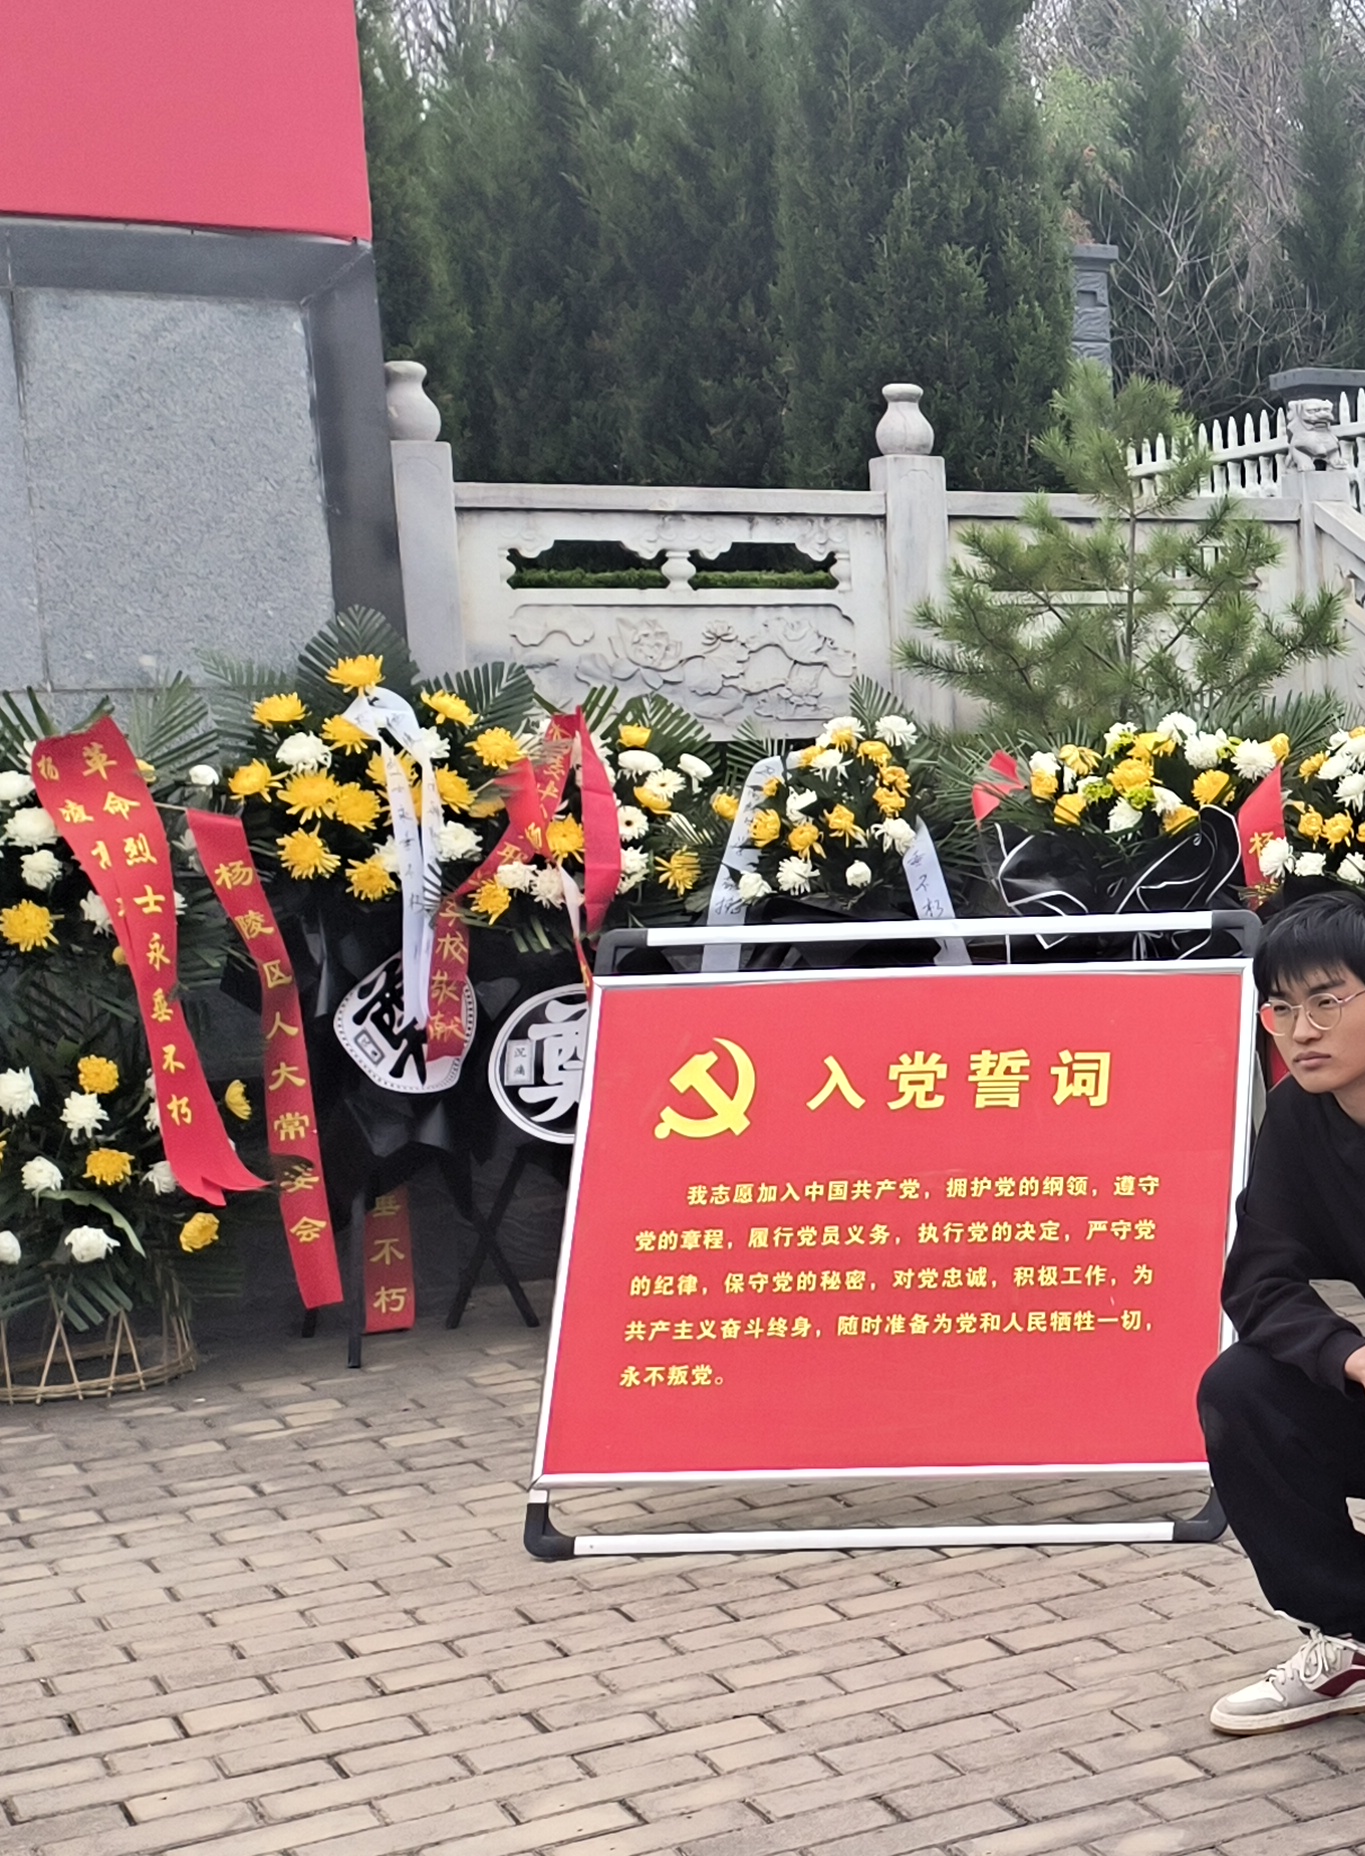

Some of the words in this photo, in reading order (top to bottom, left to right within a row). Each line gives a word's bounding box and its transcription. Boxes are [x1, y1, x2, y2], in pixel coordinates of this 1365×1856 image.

[82, 741, 193, 1127] 革命烈士永垂不朽
[214, 860, 328, 1244] 杨陵区人大常委会
[805, 1048, 1112, 1111] 入党誓词
[687, 1174, 1161, 1206] 我志愿加入中国共产党，拥护党的纲领，遵守
[634, 1218, 1157, 1252] 党的章程，履行党员义务，执行党的决定，严守党
[629, 1263, 1154, 1297] 的纪律，保守党的秘密，对党忠诚，积极工作，为
[624, 1309, 1153, 1342] 共产主义奋斗终身，随时准备为党和人民牺牲一切，
[618, 1363, 724, 1388] 永不叛党。
